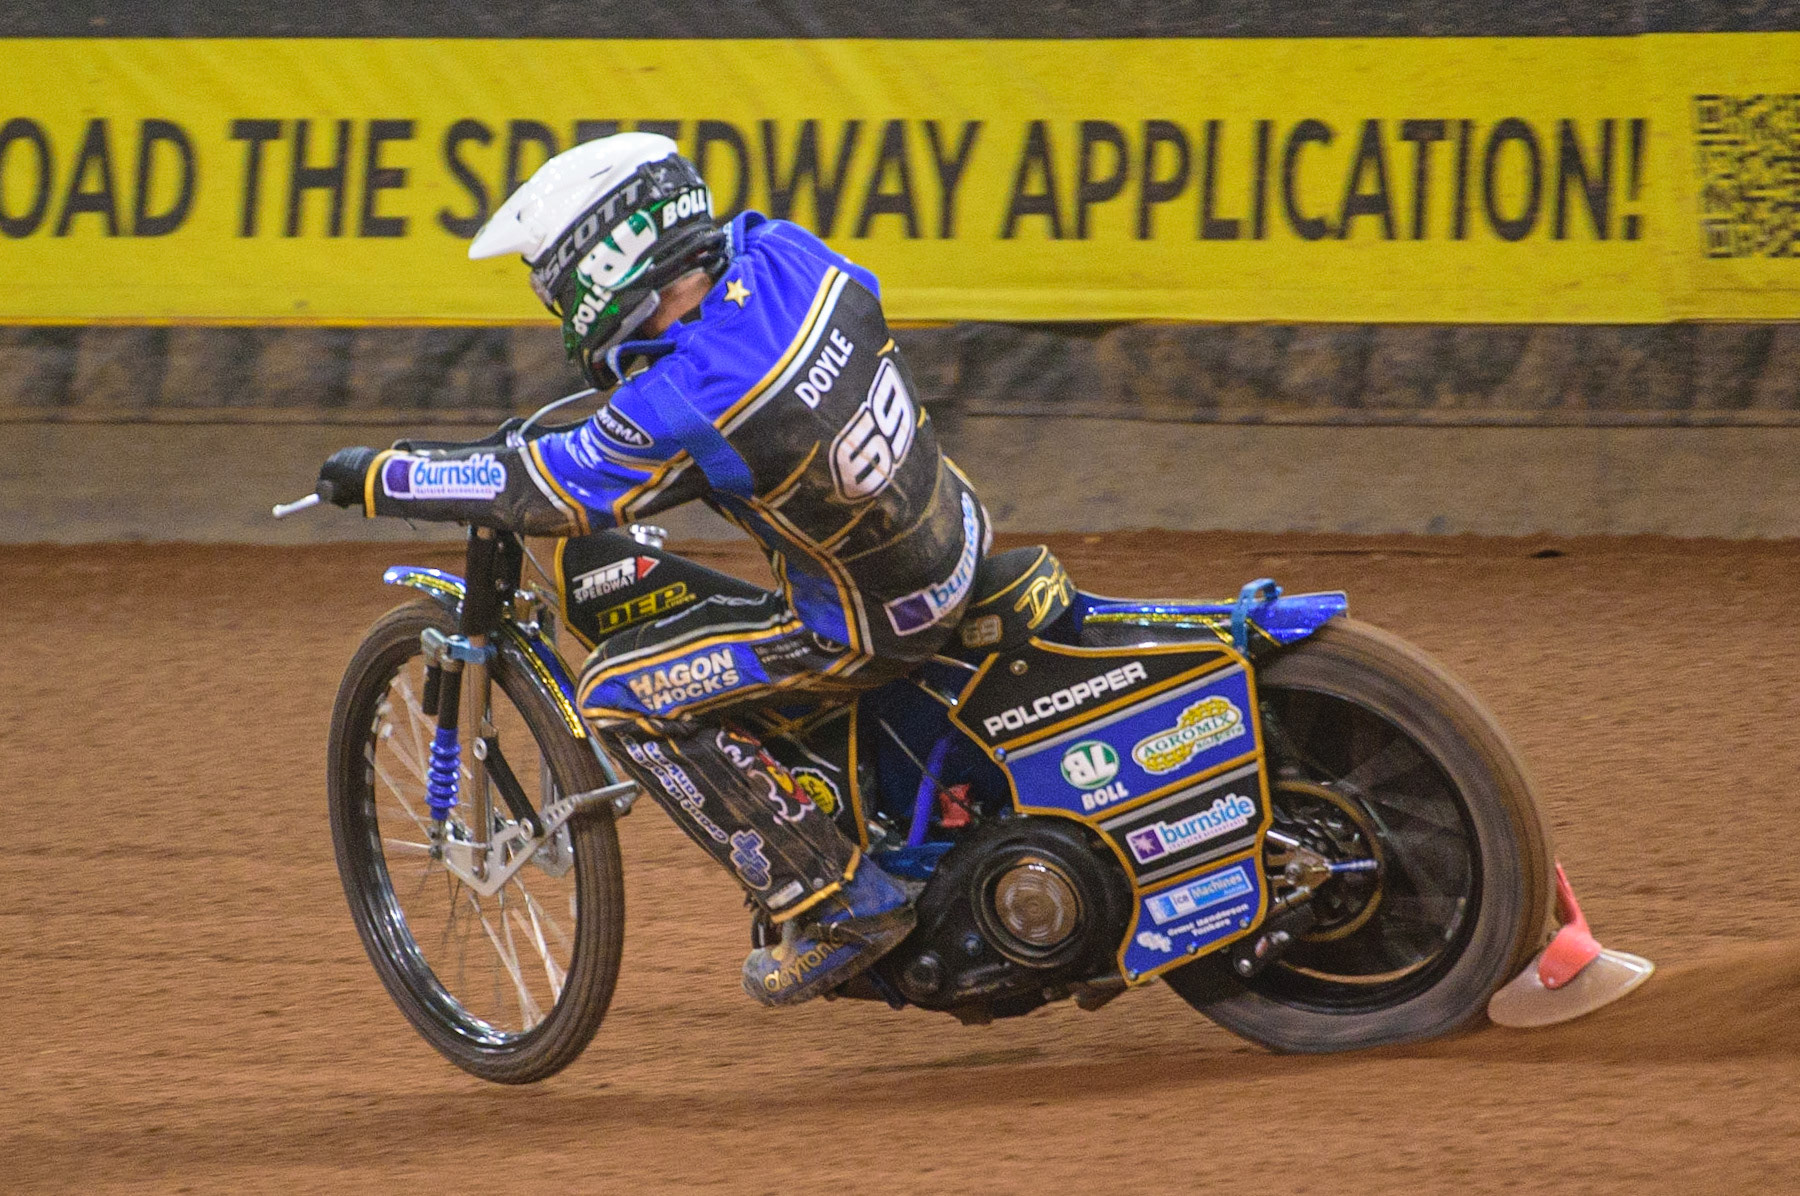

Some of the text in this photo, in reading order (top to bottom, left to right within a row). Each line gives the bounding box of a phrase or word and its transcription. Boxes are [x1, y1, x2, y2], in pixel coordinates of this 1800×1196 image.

[228, 118, 415, 238] THE
[440, 117, 987, 240] SPDWAY
[997, 117, 1648, 241] APPLICATION!
[543, 179, 643, 287] SCOTT
[794, 328, 855, 410] DOYLE
[831, 358, 915, 501] 69
[414, 458, 502, 487] burnside
[573, 573, 636, 603] SPEEDWAY
[596, 581, 688, 634] DEP
[629, 648, 734, 699] HAGON
[984, 660, 1148, 737] POLCOPPER
[1143, 712, 1231, 758] AGROMIX
[1082, 780, 1130, 811] BOLL
[1159, 797, 1250, 844] burnside
